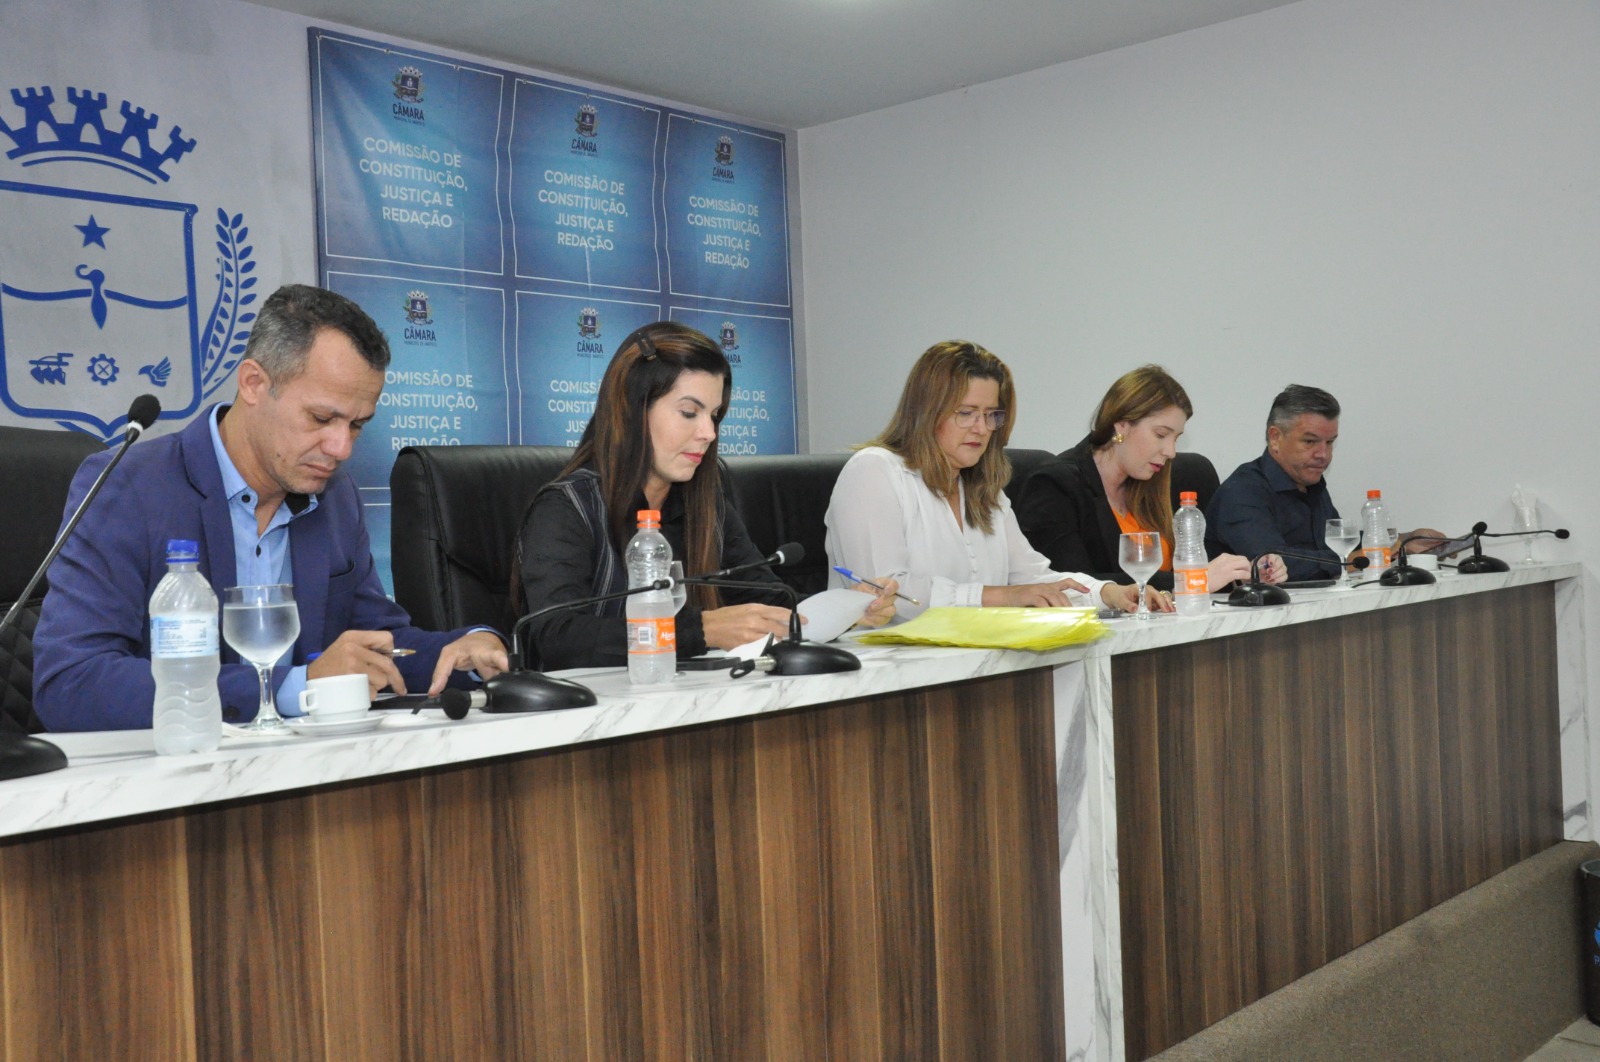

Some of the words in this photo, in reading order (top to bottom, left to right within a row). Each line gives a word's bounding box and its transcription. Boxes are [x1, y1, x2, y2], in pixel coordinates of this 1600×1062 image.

[392, 102, 425, 121] CÂMARA
[363, 137, 440, 164] COMISSÃO
[443, 153, 462, 168] DE
[571, 137, 597, 153] CÂMARA
[359, 158, 468, 192] CONSTITUIÇÃO,
[544, 169, 608, 192] COMISSÃO
[610, 182, 625, 196] DE
[712, 166, 735, 180] CÂMARA
[380, 184, 443, 207] JUSTIÇA
[446, 193, 454, 207] E
[537, 189, 629, 217] CONSTITUIÇÃO,
[688, 195, 746, 214] COMISSÃO
[747, 204, 759, 217] DE
[382, 206, 453, 229] REDAÇÃO
[555, 212, 605, 233] JUSTIÇA
[608, 220, 614, 232] E
[687, 213, 762, 237] CONSTITUIÇÃO,
[557, 231, 614, 251] REDAÇÃO
[703, 233, 743, 251] JUSTIÇA
[745, 239, 750, 251] E
[705, 251, 750, 270] REDAÇÃO
[404, 326, 437, 342] CÂMARA
[576, 340, 604, 354] CÂMARA
[724, 353, 742, 364] MARA
[384, 369, 453, 387] OMISSÃO
[455, 374, 473, 388] DE
[550, 379, 602, 394] COMISS
[376, 391, 478, 412] ONSTITUIÇÃO,
[752, 390, 766, 402] DE
[548, 399, 596, 413] CONSTIT
[725, 405, 770, 422] ITUIÇÃO,
[390, 415, 450, 433] JUSTIÇA
[453, 416, 462, 430] E
[718, 424, 750, 440] STIÇA
[751, 426, 757, 437] E
[717, 440, 757, 456] EDAÇÃO
